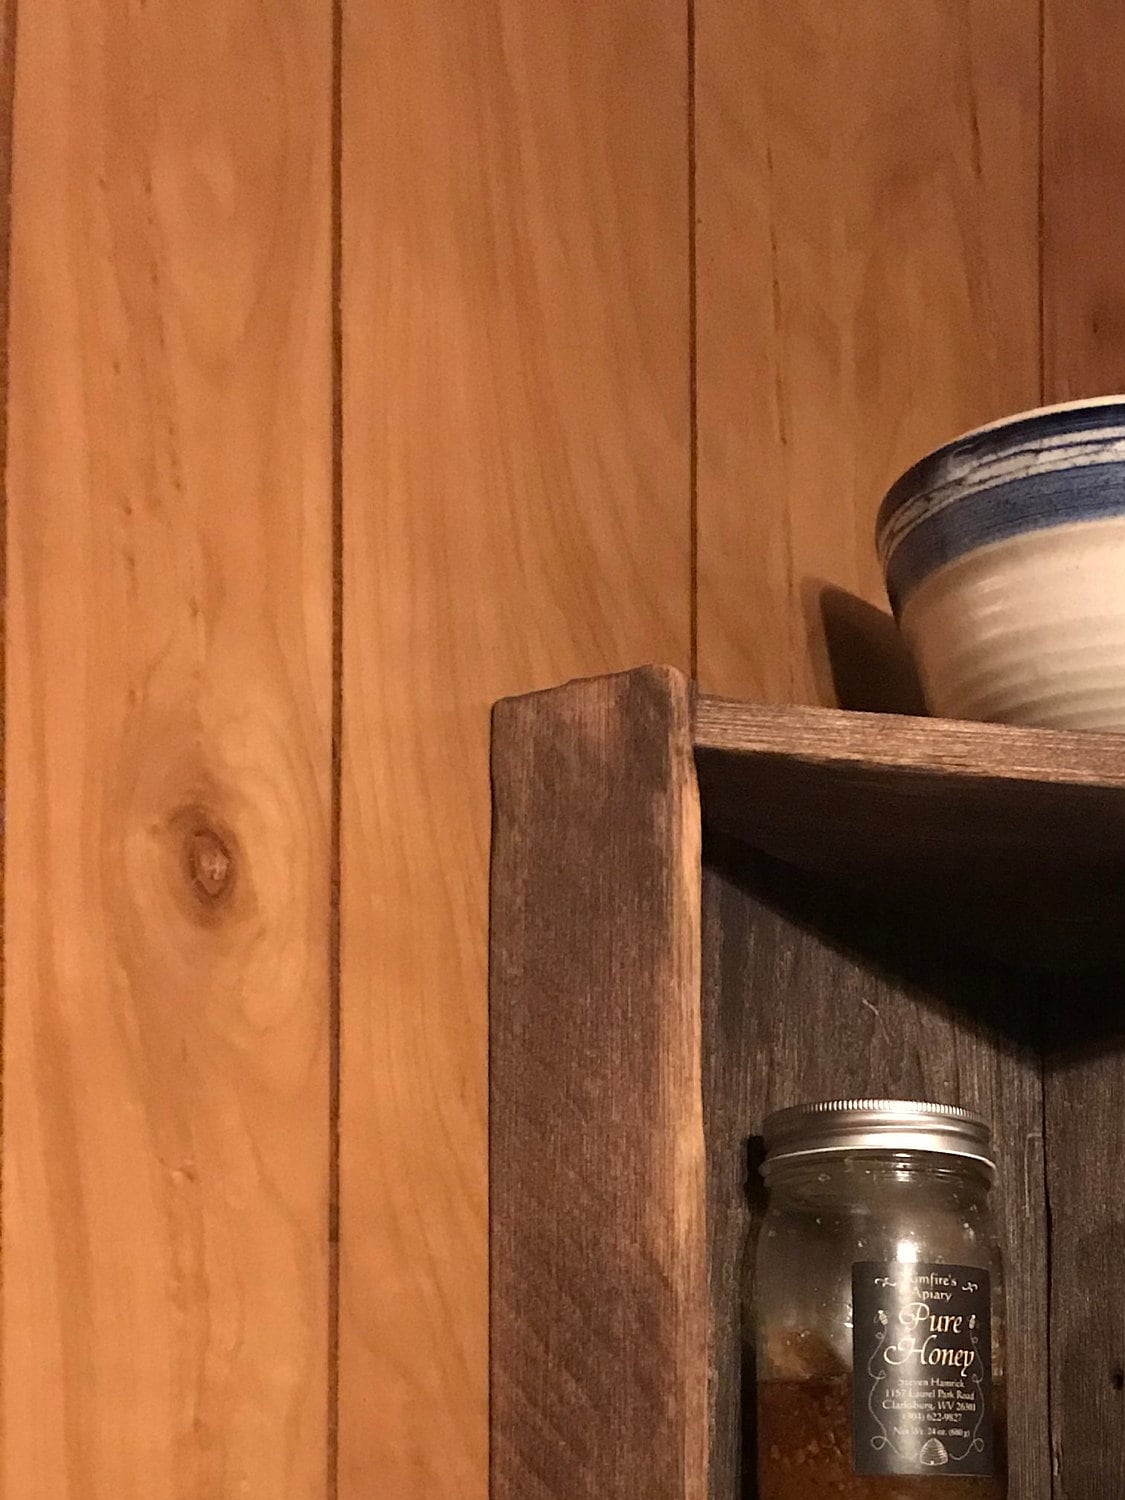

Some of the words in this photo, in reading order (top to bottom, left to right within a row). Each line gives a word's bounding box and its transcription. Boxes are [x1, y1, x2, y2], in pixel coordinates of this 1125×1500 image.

[911, 1286, 952, 1301] Apiary
[898, 1302, 963, 1333] Pure
[884, 1334, 976, 1377] Honey
[930, 1377, 965, 1388] Hamrick
[885, 1388, 906, 1399] 1157
[908, 1388, 935, 1399] Laurel
[937, 1389, 954, 1399] Park
[956, 1390, 975, 1401] Road
[937, 1401, 954, 1411] WV
[926, 1413, 962, 1422] 622-9827
[927, 1427, 936, 1436] 24
